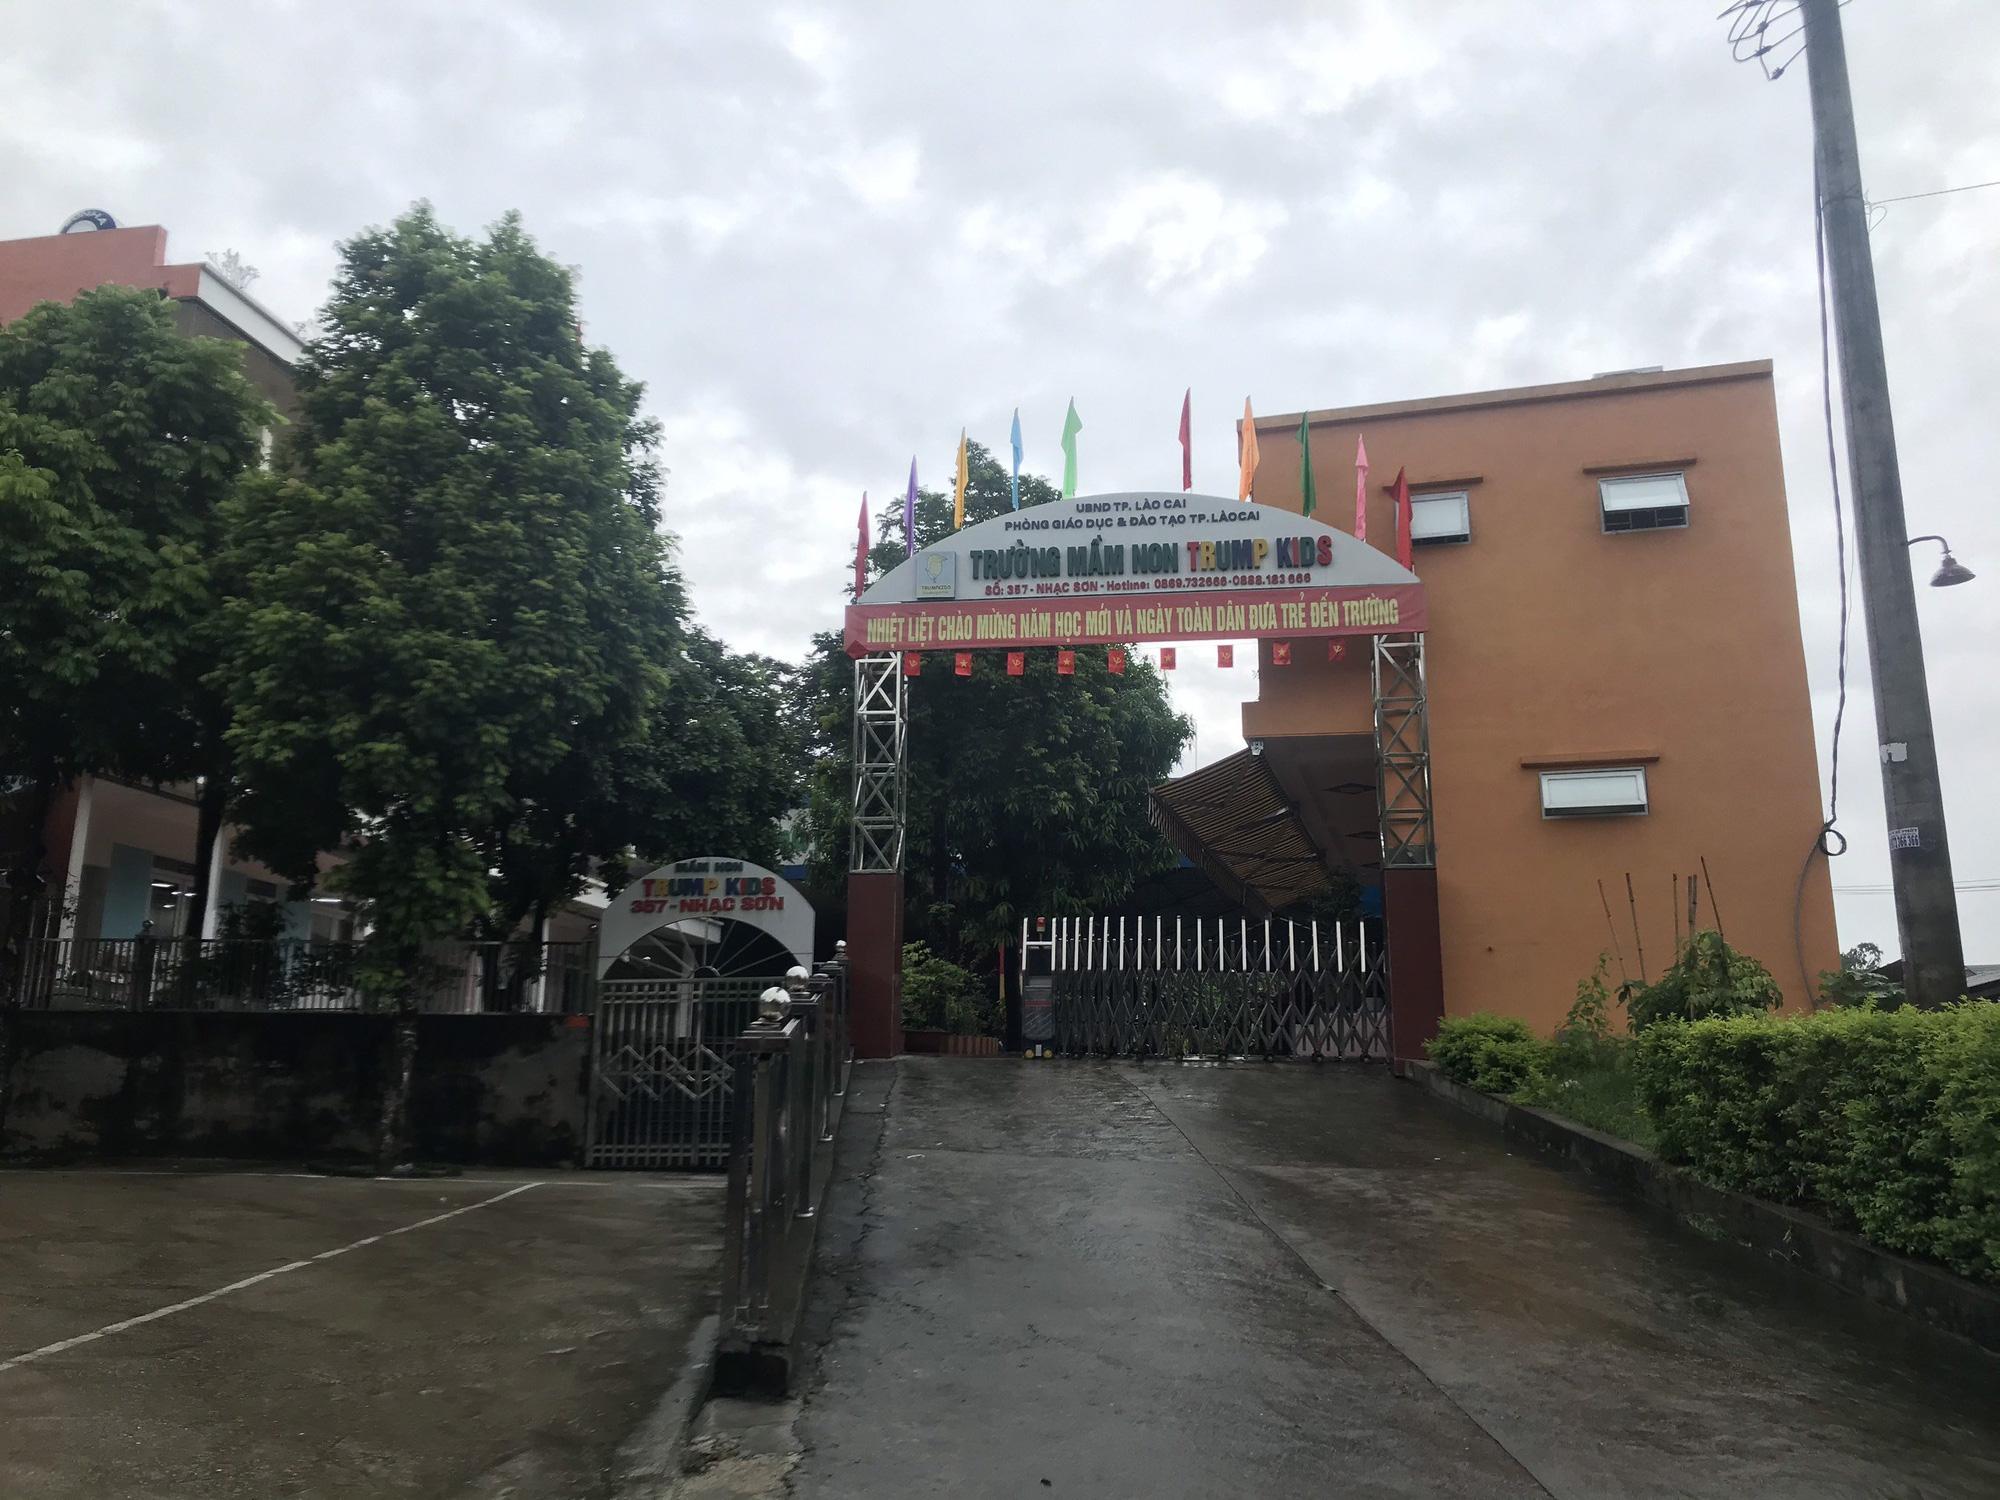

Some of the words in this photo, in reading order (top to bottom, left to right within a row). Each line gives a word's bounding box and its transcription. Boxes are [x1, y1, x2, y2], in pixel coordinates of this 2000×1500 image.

[1076, 502, 1111, 514] UBND
[1113, 501, 1132, 512] TP.
[1135, 498, 1161, 511] LÀO
[1164, 498, 1186, 510] CAI
[1004, 515, 1049, 532] PHÒNG
[1051, 516, 1083, 530] GIÁO
[1086, 518, 1113, 531] DỤC
[1116, 517, 1127, 528] &
[1129, 512, 1156, 527] ĐÀO
[1158, 514, 1186, 528] TẠO
[970, 538, 1061, 580] TRƯỜNG
[1067, 534, 1124, 578] MẦM
[1131, 541, 1179, 575] NON
[1186, 538, 1269, 573] TRUMP
[1276, 534, 1333, 569] KIDS
[1006, 584, 1029, 595] 357
[1035, 582, 1069, 596] NHẠC
[1073, 580, 1099, 593] SƠN
[867, 612, 905, 648] NHIỆT
[907, 611, 935, 648] LIỆT
[937, 609, 973, 641] CHÀO
[976, 607, 1016, 640] MỪNG
[1020, 607, 1051, 638] NĂM
[1054, 610, 1082, 642] HỌC
[1085, 602, 1112, 636] MỚI
[1115, 603, 1134, 635] VÀ
[1136, 602, 1173, 635] NGÀY
[1176, 600, 1213, 633] TOÀN
[1216, 599, 1246, 632] DÂN
[1249, 602, 1278, 630] ĐƯA
[1280, 591, 1307, 629] TRẺ
[1310, 591, 1339, 628] ĐẾN
[1342, 592, 1399, 627] TRƯỜNG
[642, 877, 719, 898] TRUMP
[725, 876, 776, 897] KIDS
[632, 899, 668, 914] 357
[679, 897, 736, 915] NHẠC
[741, 894, 785, 911] SƠN
